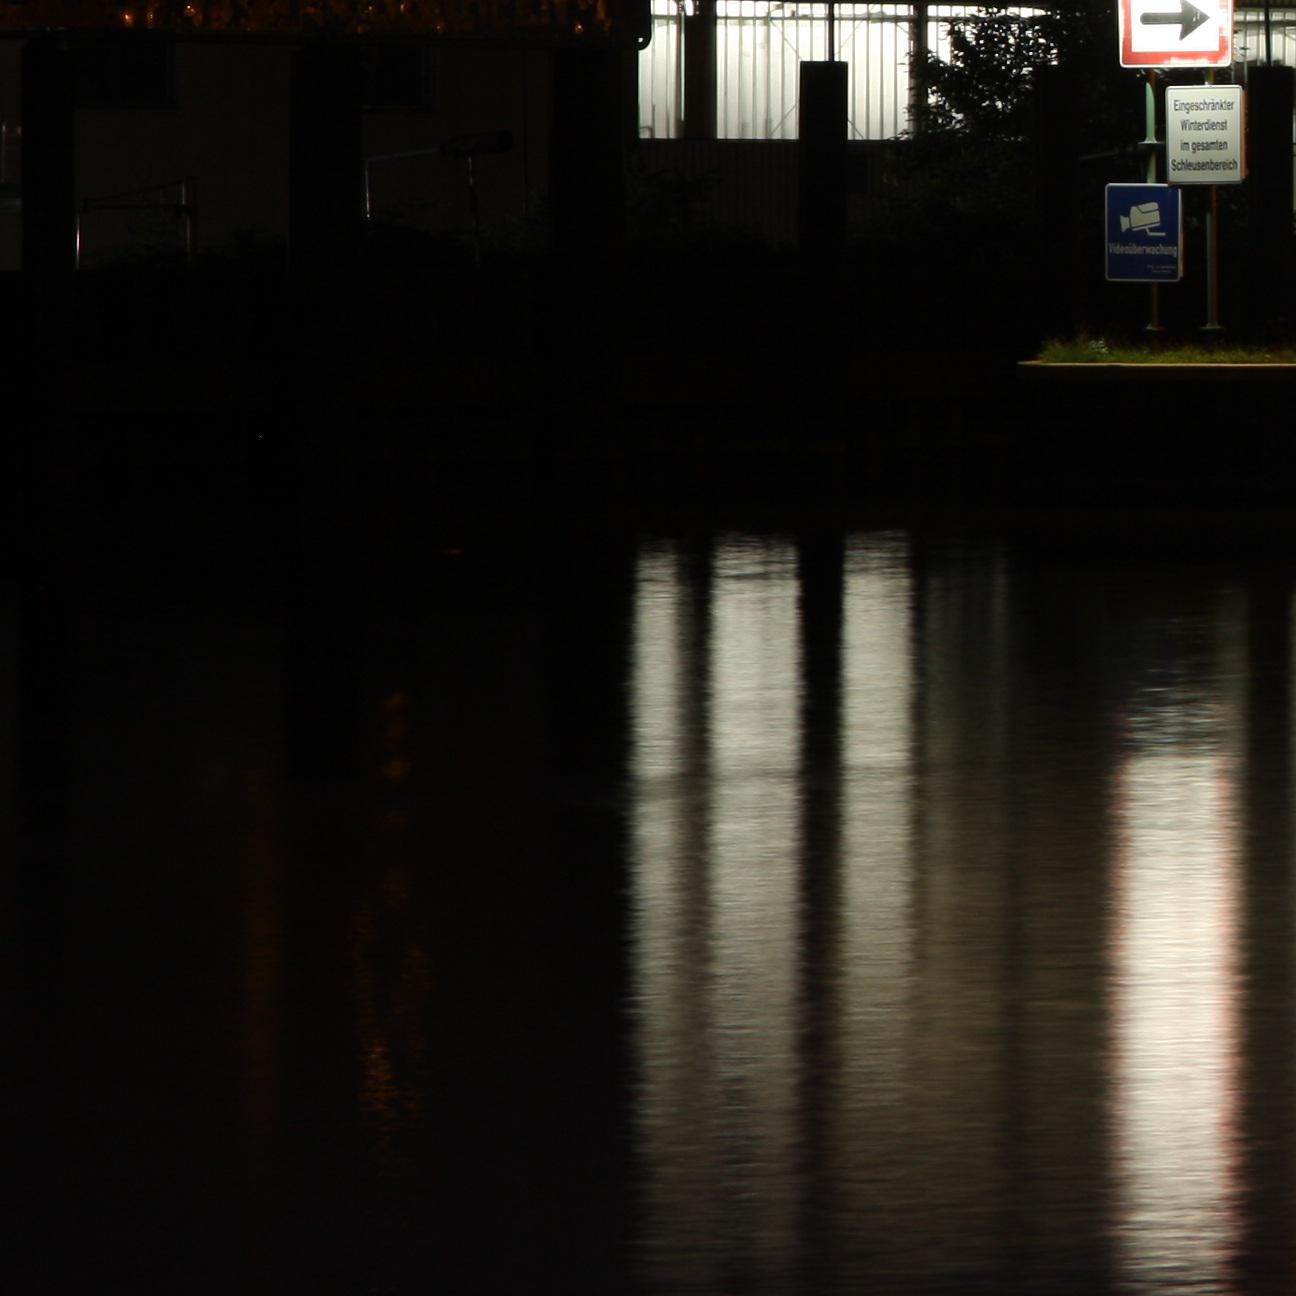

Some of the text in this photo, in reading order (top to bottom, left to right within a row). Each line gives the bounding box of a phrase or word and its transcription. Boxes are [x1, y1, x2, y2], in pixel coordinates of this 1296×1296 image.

[1173, 99, 1235, 114] Eingeschränkter
[1180, 119, 1228, 131] Winterdienst
[1180, 139, 1228, 154] im gesamten
[1170, 158, 1238, 172] Schleusenbereich
